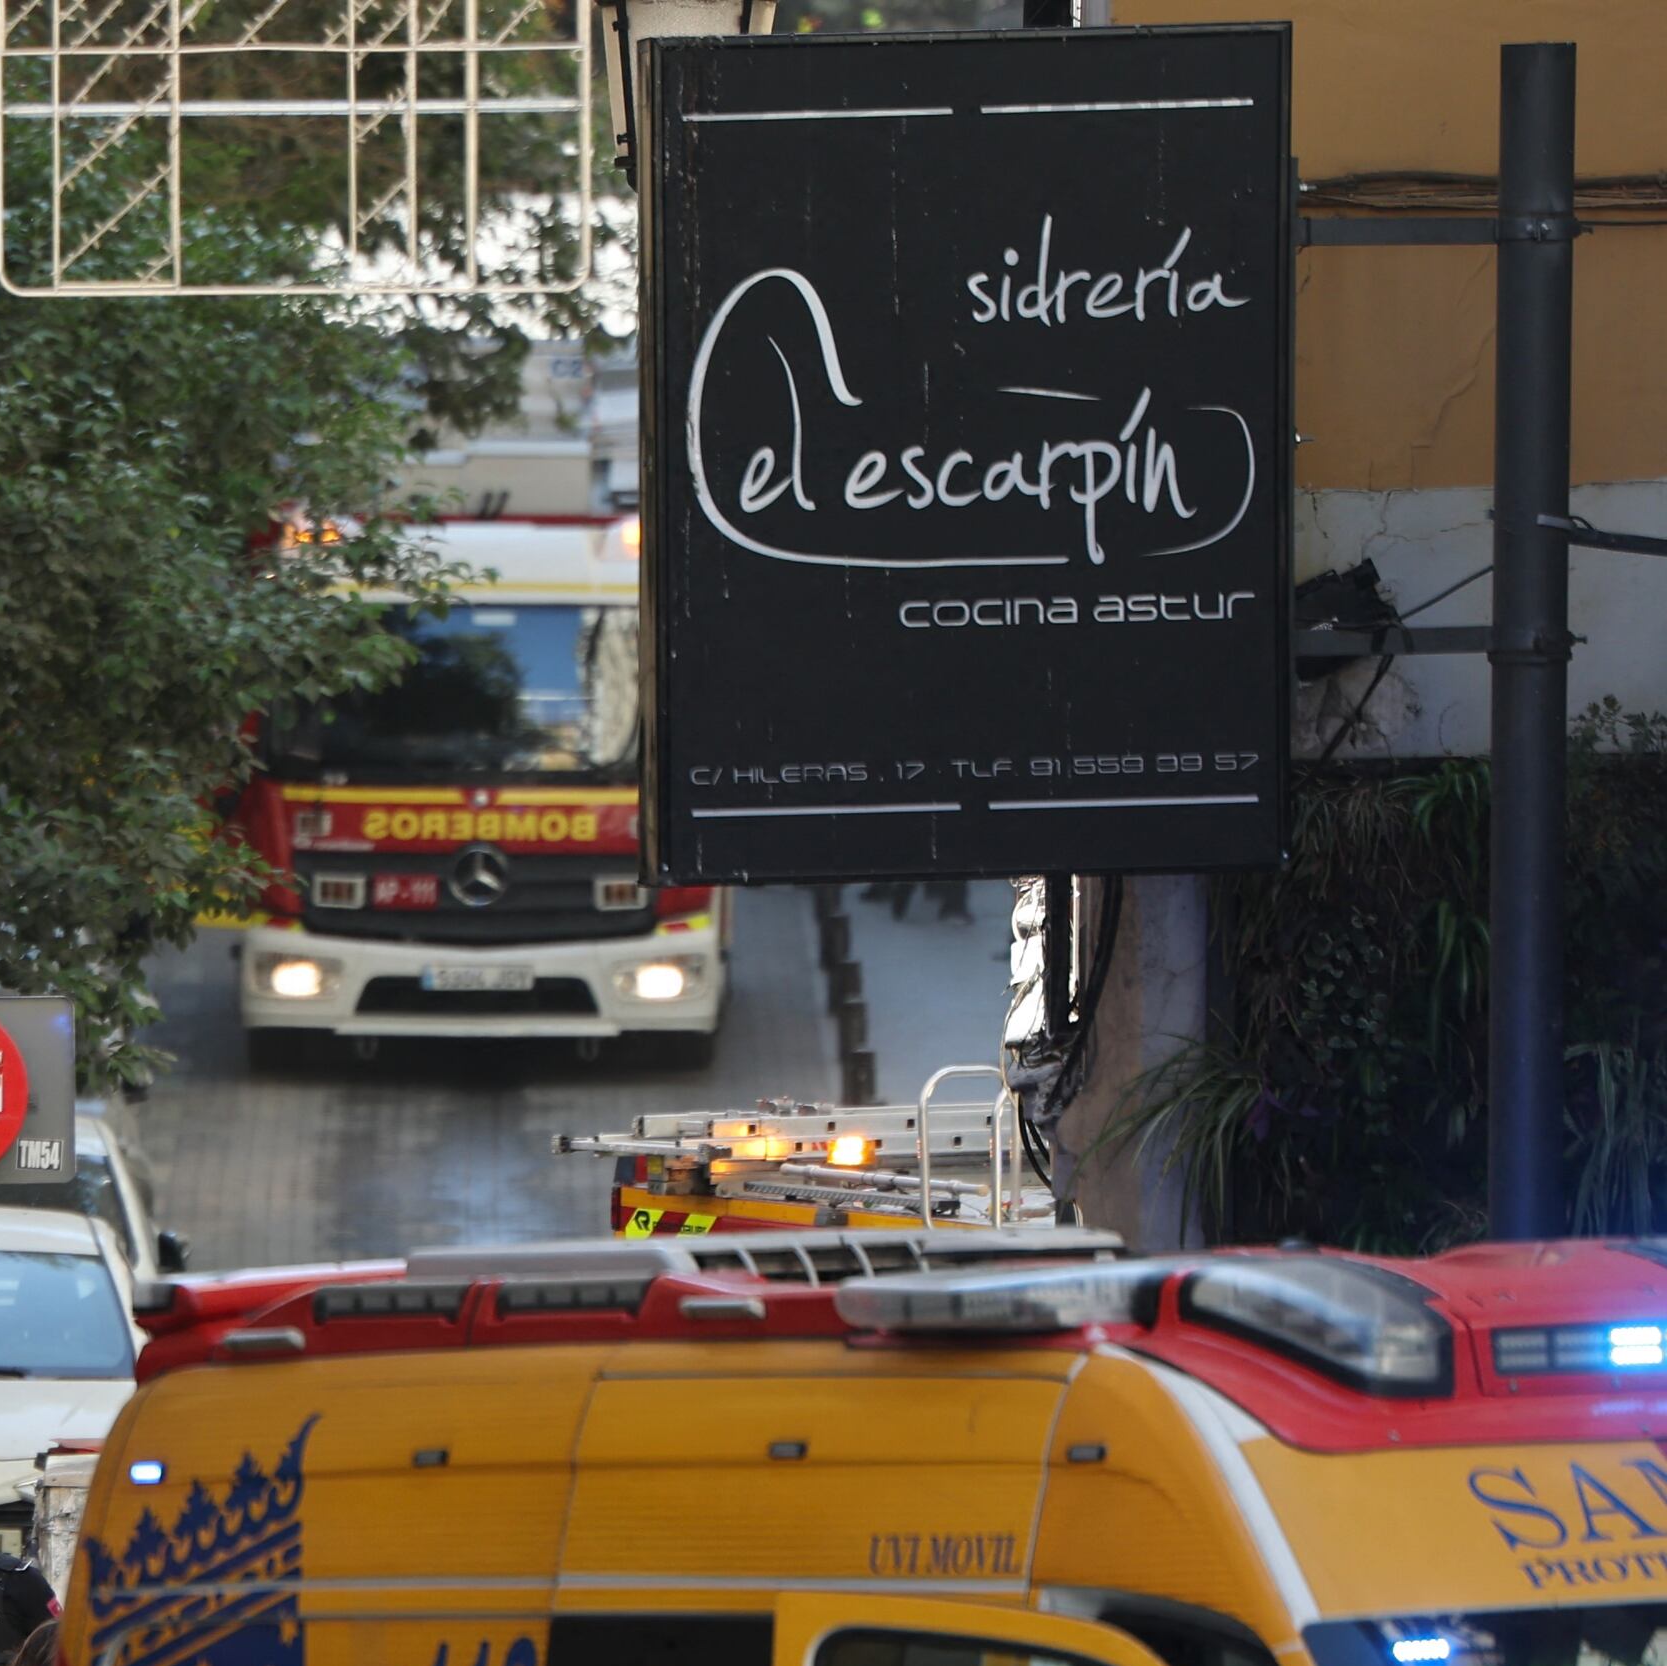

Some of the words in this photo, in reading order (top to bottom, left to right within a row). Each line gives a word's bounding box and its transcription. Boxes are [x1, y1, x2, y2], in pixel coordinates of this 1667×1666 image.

[967, 213, 1250, 326] sidrería
[739, 334, 817, 513] el
[844, 387, 1197, 565] escarpín
[899, 598, 1079, 628] cocina
[1093, 592, 1256, 624] astur
[690, 766, 723, 786] C/
[732, 762, 868, 784] HILERAS
[896, 761, 926, 779] 17
[1031, 756, 1061, 776] 91
[1215, 753, 1260, 772] 57
[19, 1140, 61, 1170] TM54
